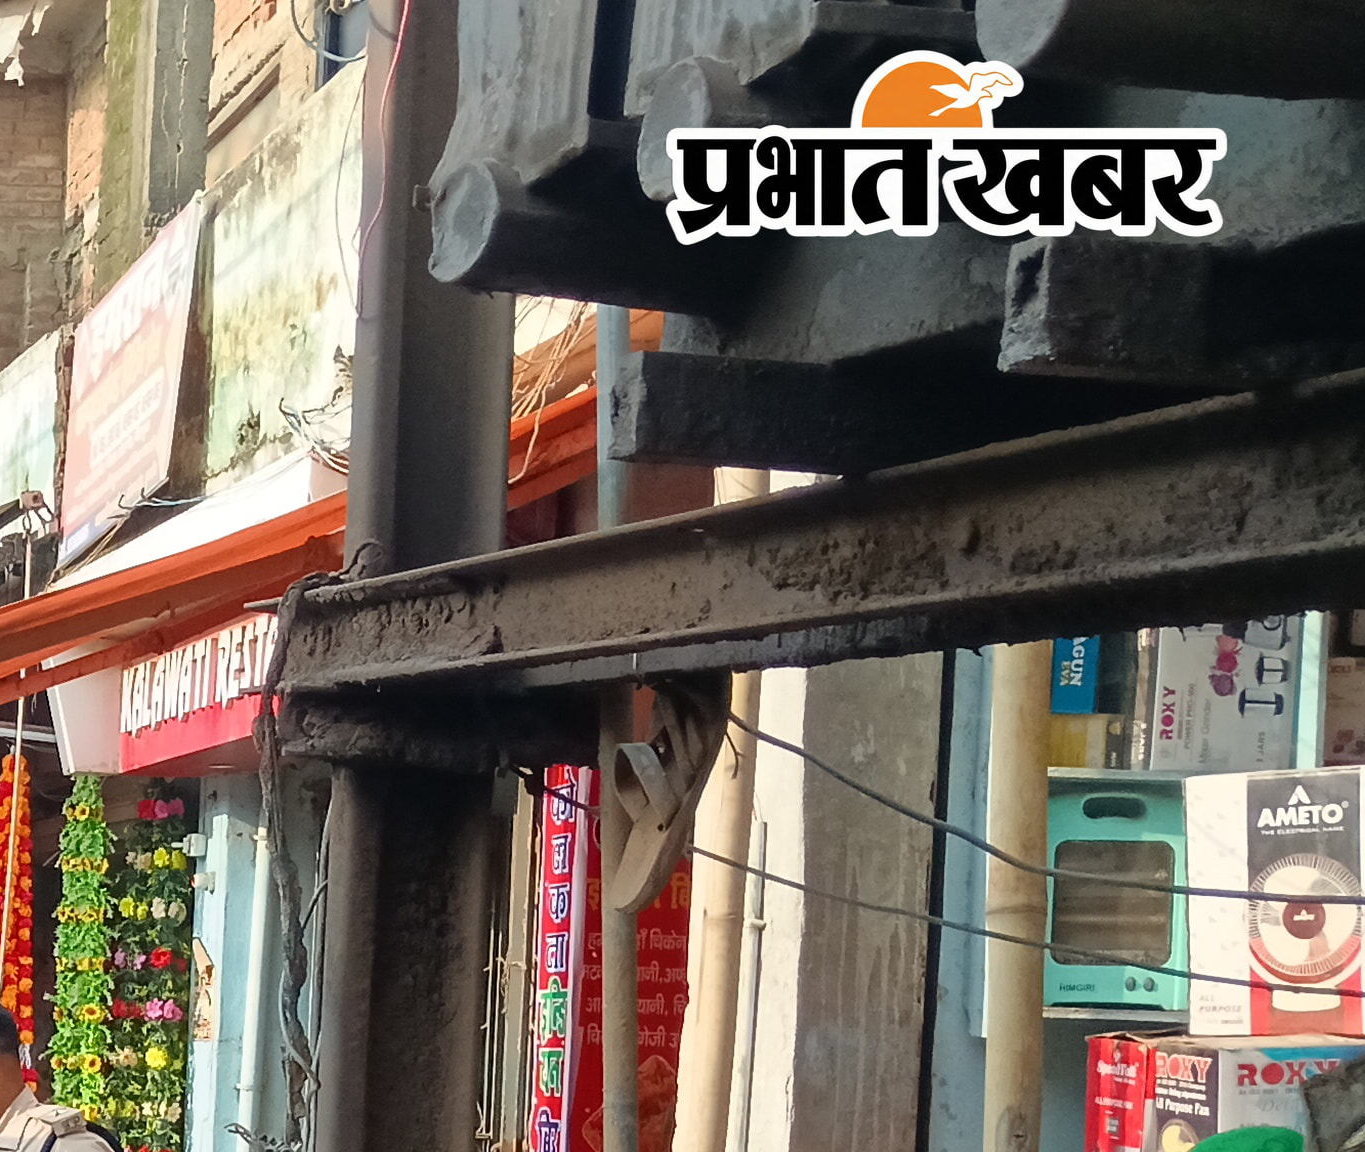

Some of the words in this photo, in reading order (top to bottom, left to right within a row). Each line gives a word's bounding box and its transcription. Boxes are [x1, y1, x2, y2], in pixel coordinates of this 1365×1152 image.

[119, 636, 213, 738] KALAWATI
[214, 613, 279, 710] RESTA
[1069, 636, 1089, 687] AGUN
[1159, 685, 1177, 741] ROXY
[1256, 802, 1344, 828] AMETO
[1059, 982, 1095, 992] HIMGIRI
[1198, 1004, 1242, 1013] PURPOSE
[1155, 1051, 1213, 1083] ROXY
[1165, 1098, 1193, 1115] Purpose
[1194, 1101, 1210, 1117] Fan
